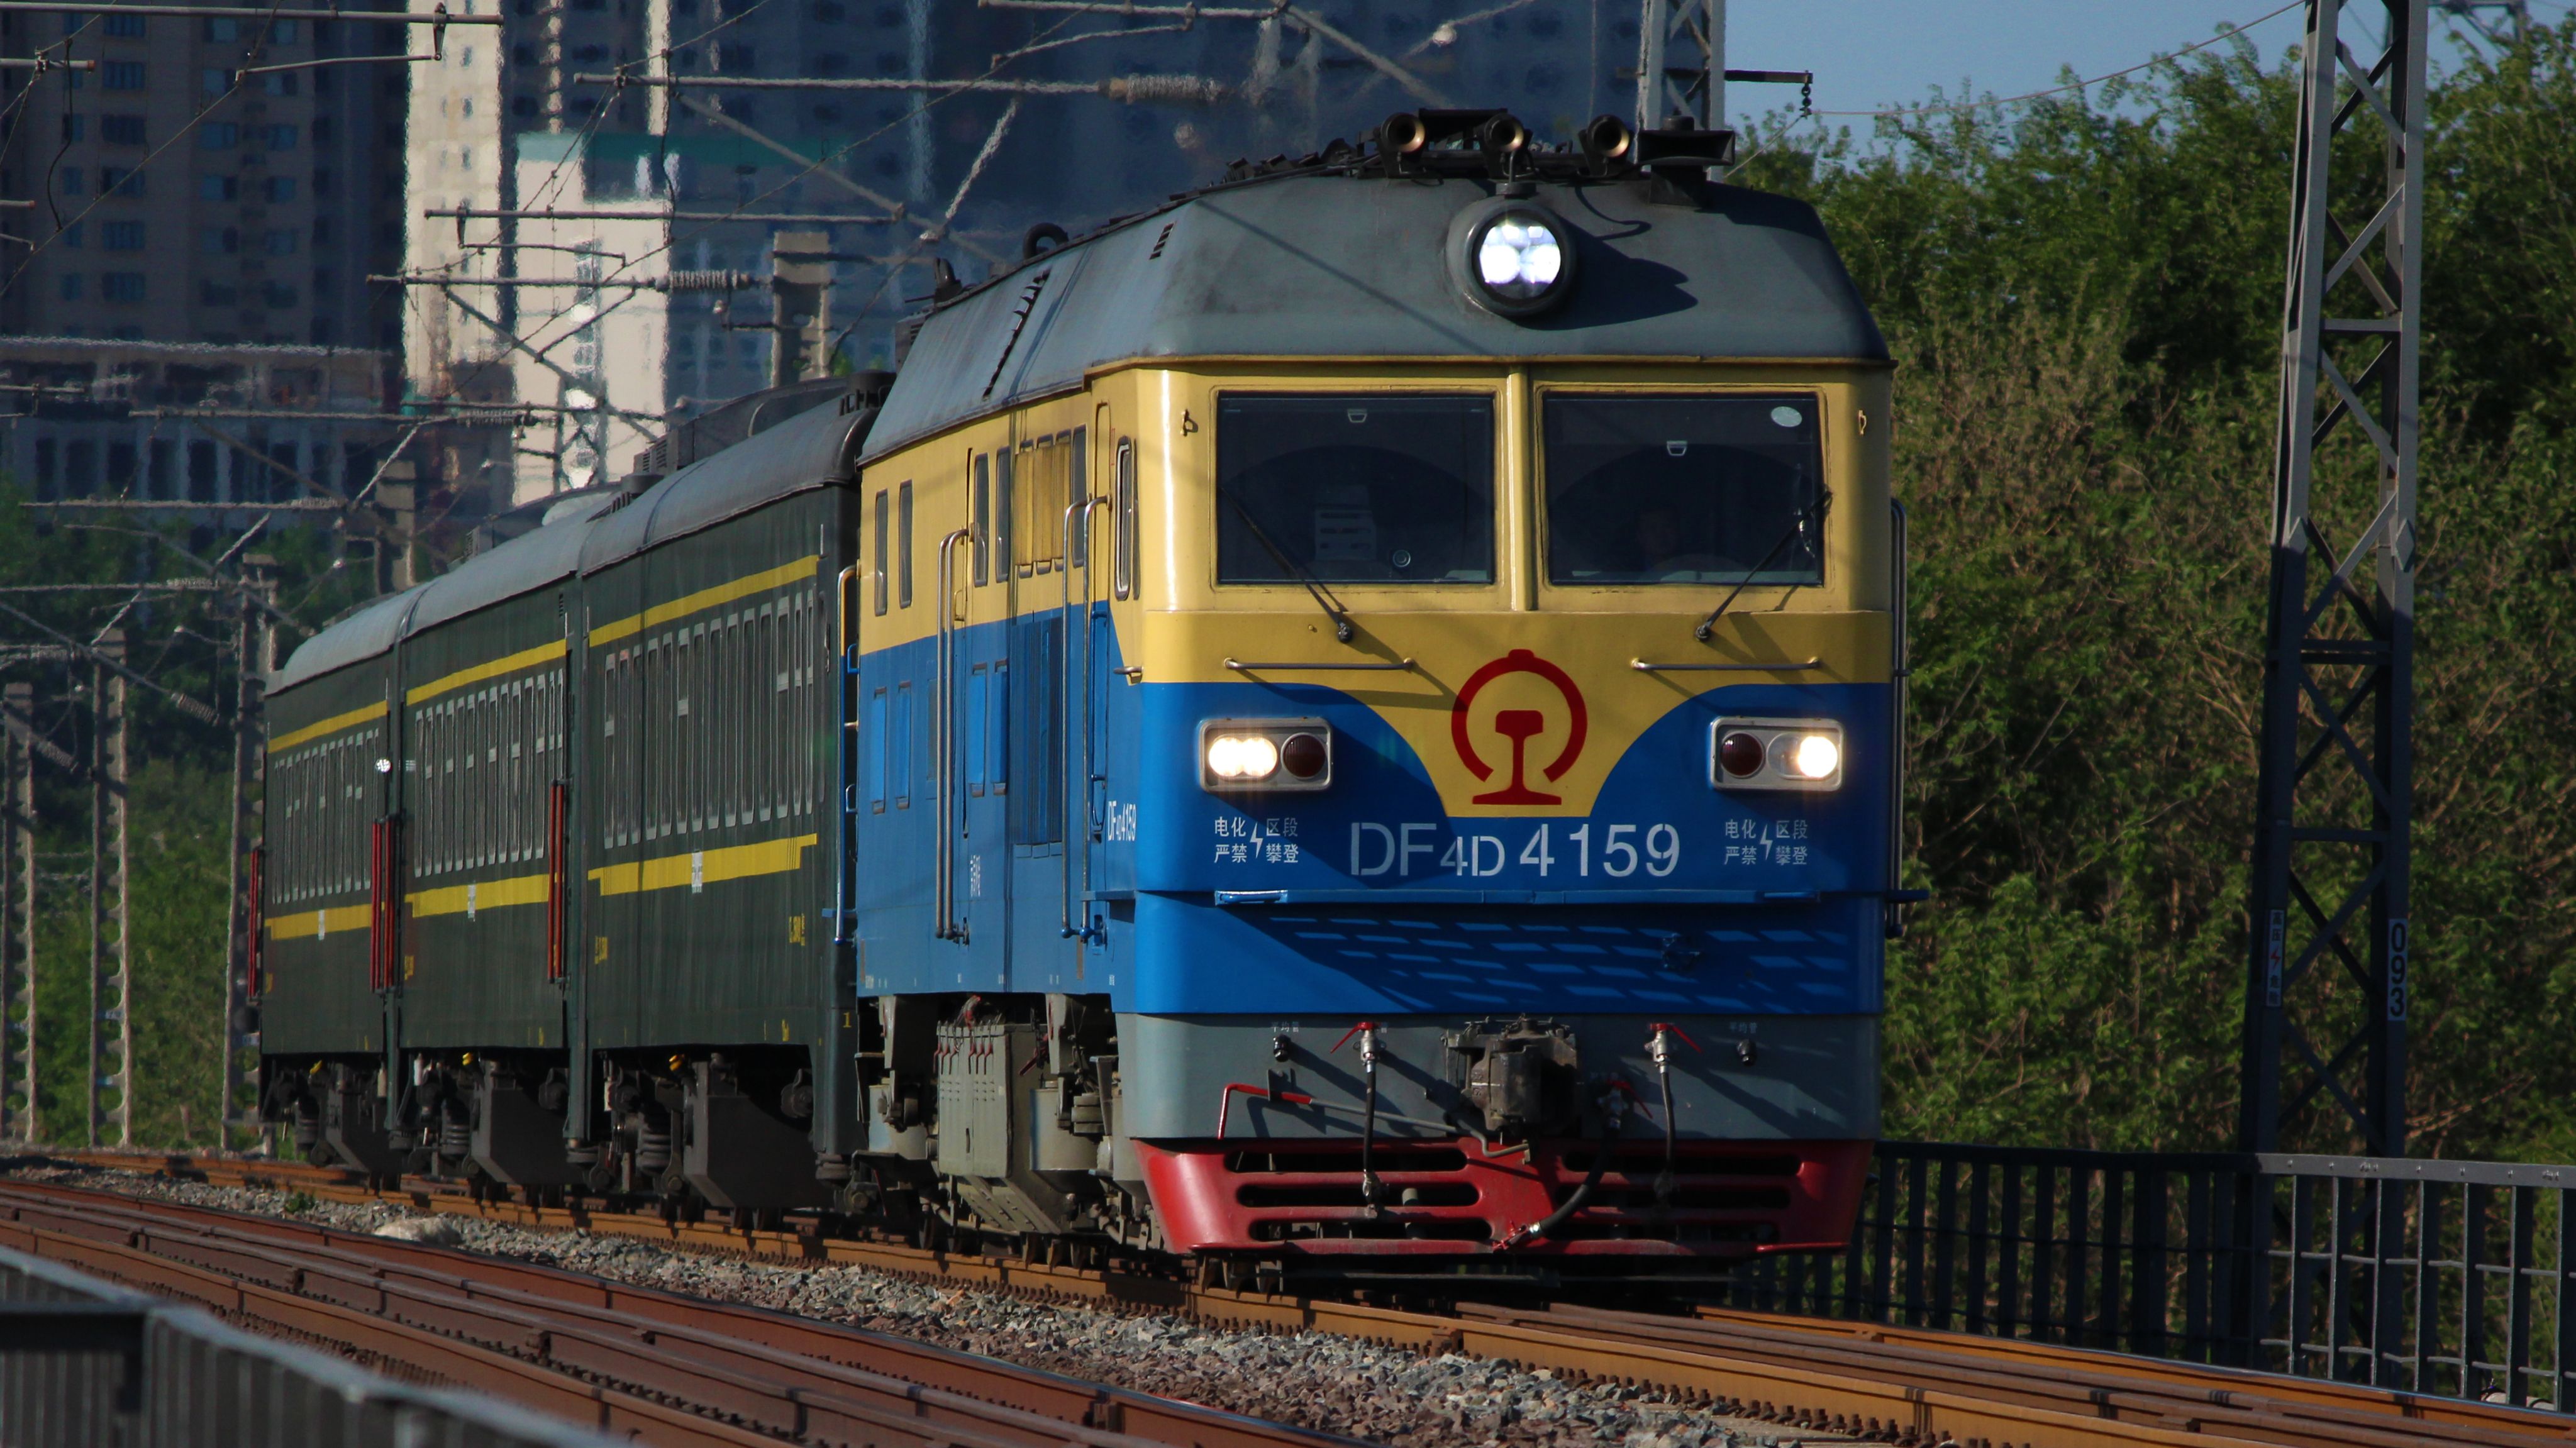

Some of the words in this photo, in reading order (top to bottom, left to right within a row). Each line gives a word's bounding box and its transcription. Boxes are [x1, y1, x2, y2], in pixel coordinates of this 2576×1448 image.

[1214, 816, 1246, 837] 电化
[1266, 817, 1298, 837] 区段
[1725, 819, 1757, 839] 电化
[1775, 819, 1808, 839] 区段
[1214, 843, 1247, 863] 严禁
[1266, 843, 1299, 863] 攀登
[1519, 823, 1680, 877] 4159
[1724, 846, 1757, 865] 严禁
[1775, 845, 1808, 866] 攀登
[2390, 922, 2407, 1017] 093
[842, 1011, 852, 1028] 1
